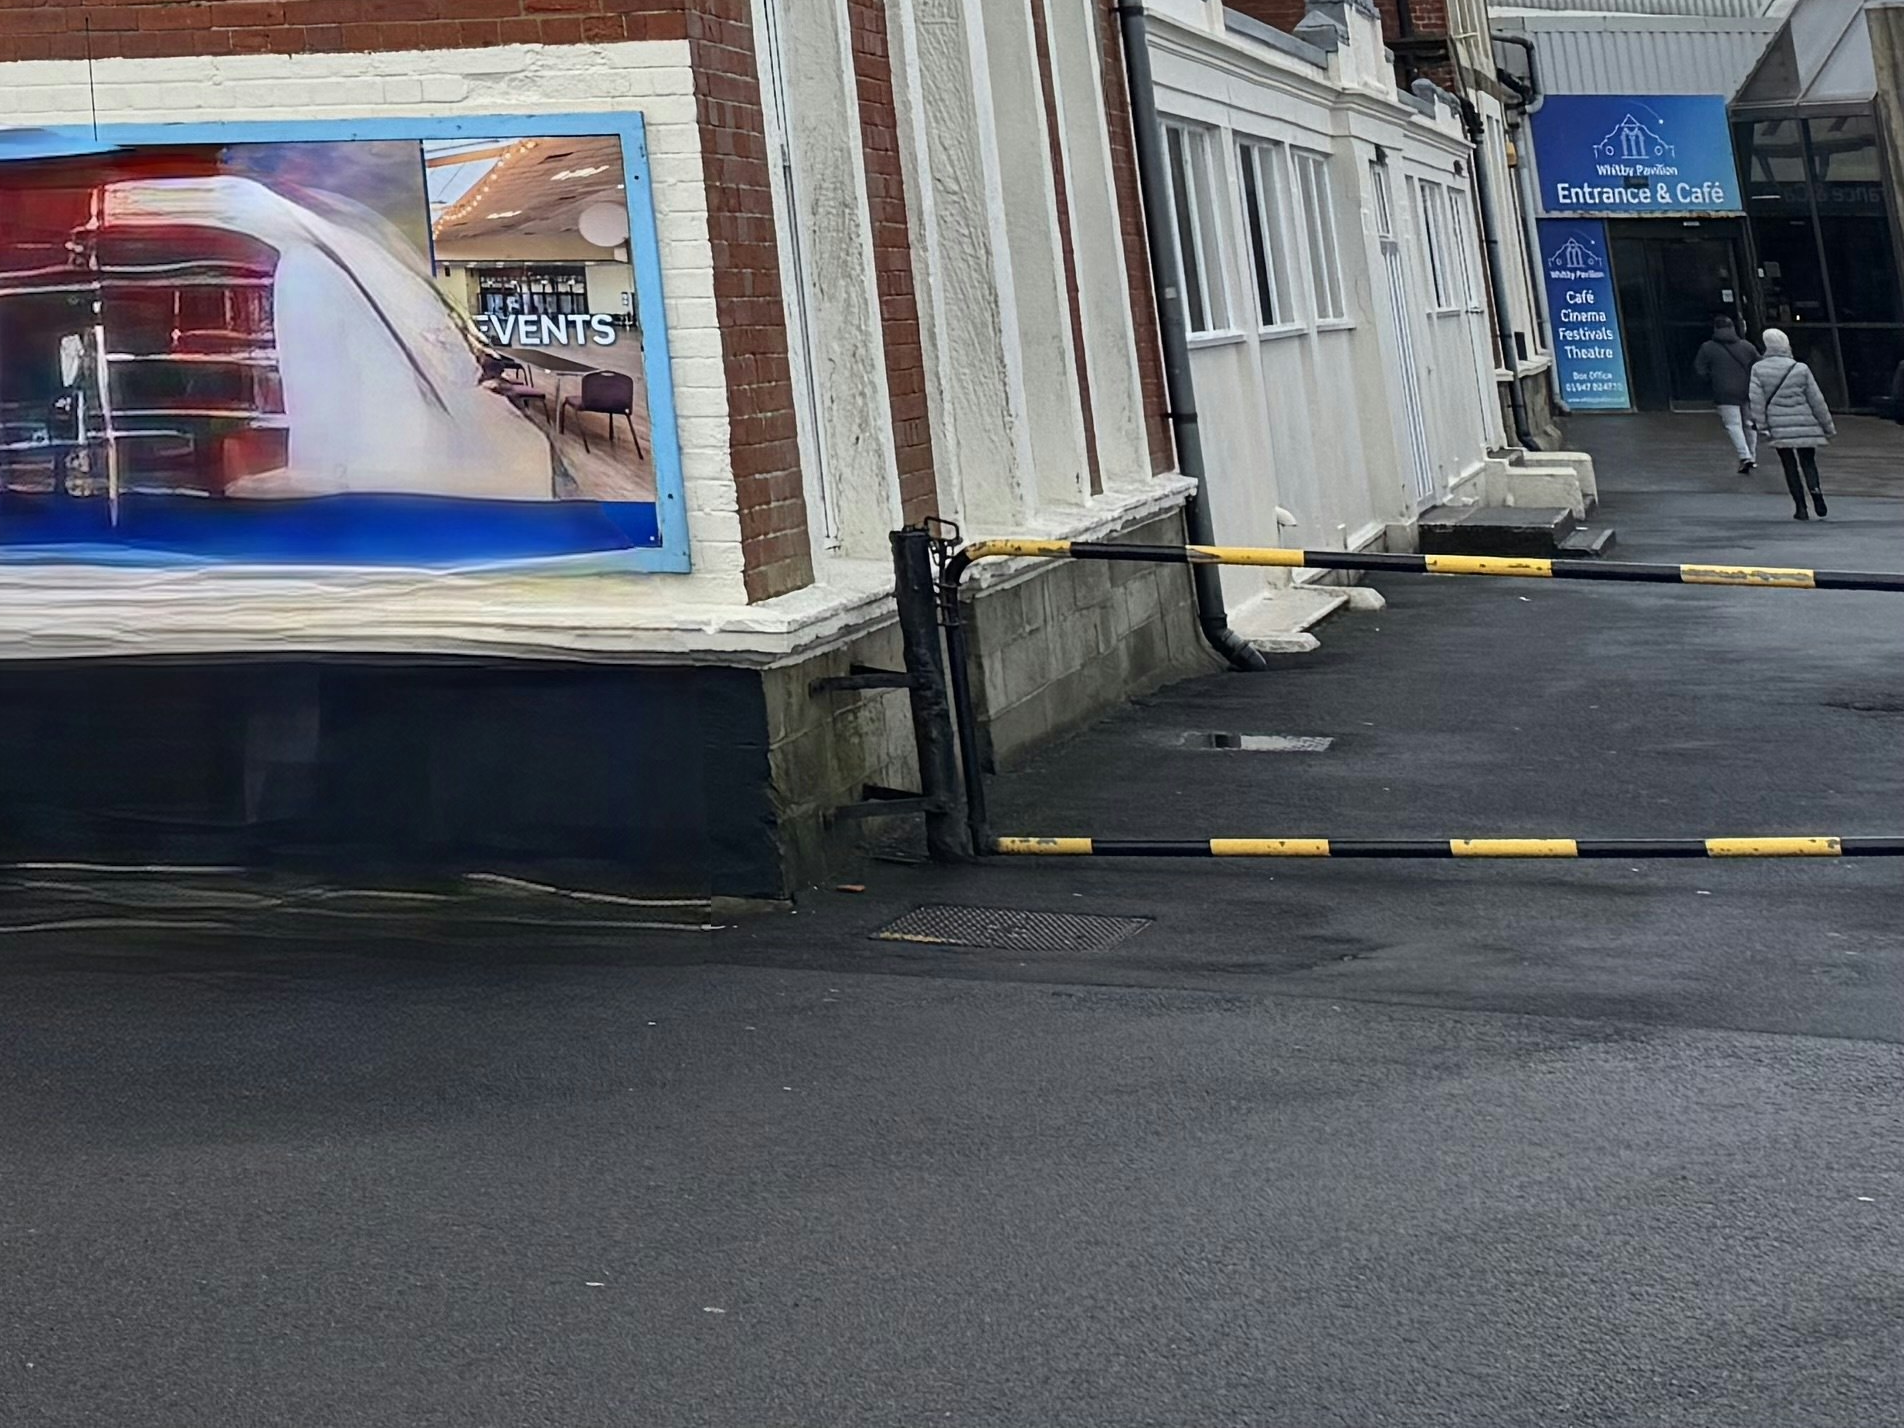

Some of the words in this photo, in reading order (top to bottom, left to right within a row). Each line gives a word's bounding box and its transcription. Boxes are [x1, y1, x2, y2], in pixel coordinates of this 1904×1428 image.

[1596, 164, 1633, 177] Whitby
[1557, 182, 1651, 204] Entrance
[1657, 182, 1672, 204] &
[1676, 181, 1724, 204] Café
[1566, 290, 1595, 304] Café
[1561, 310, 1606, 323] Cinema
[1558, 327, 1613, 341] Festivals
[1564, 345, 1613, 359] Theatre
